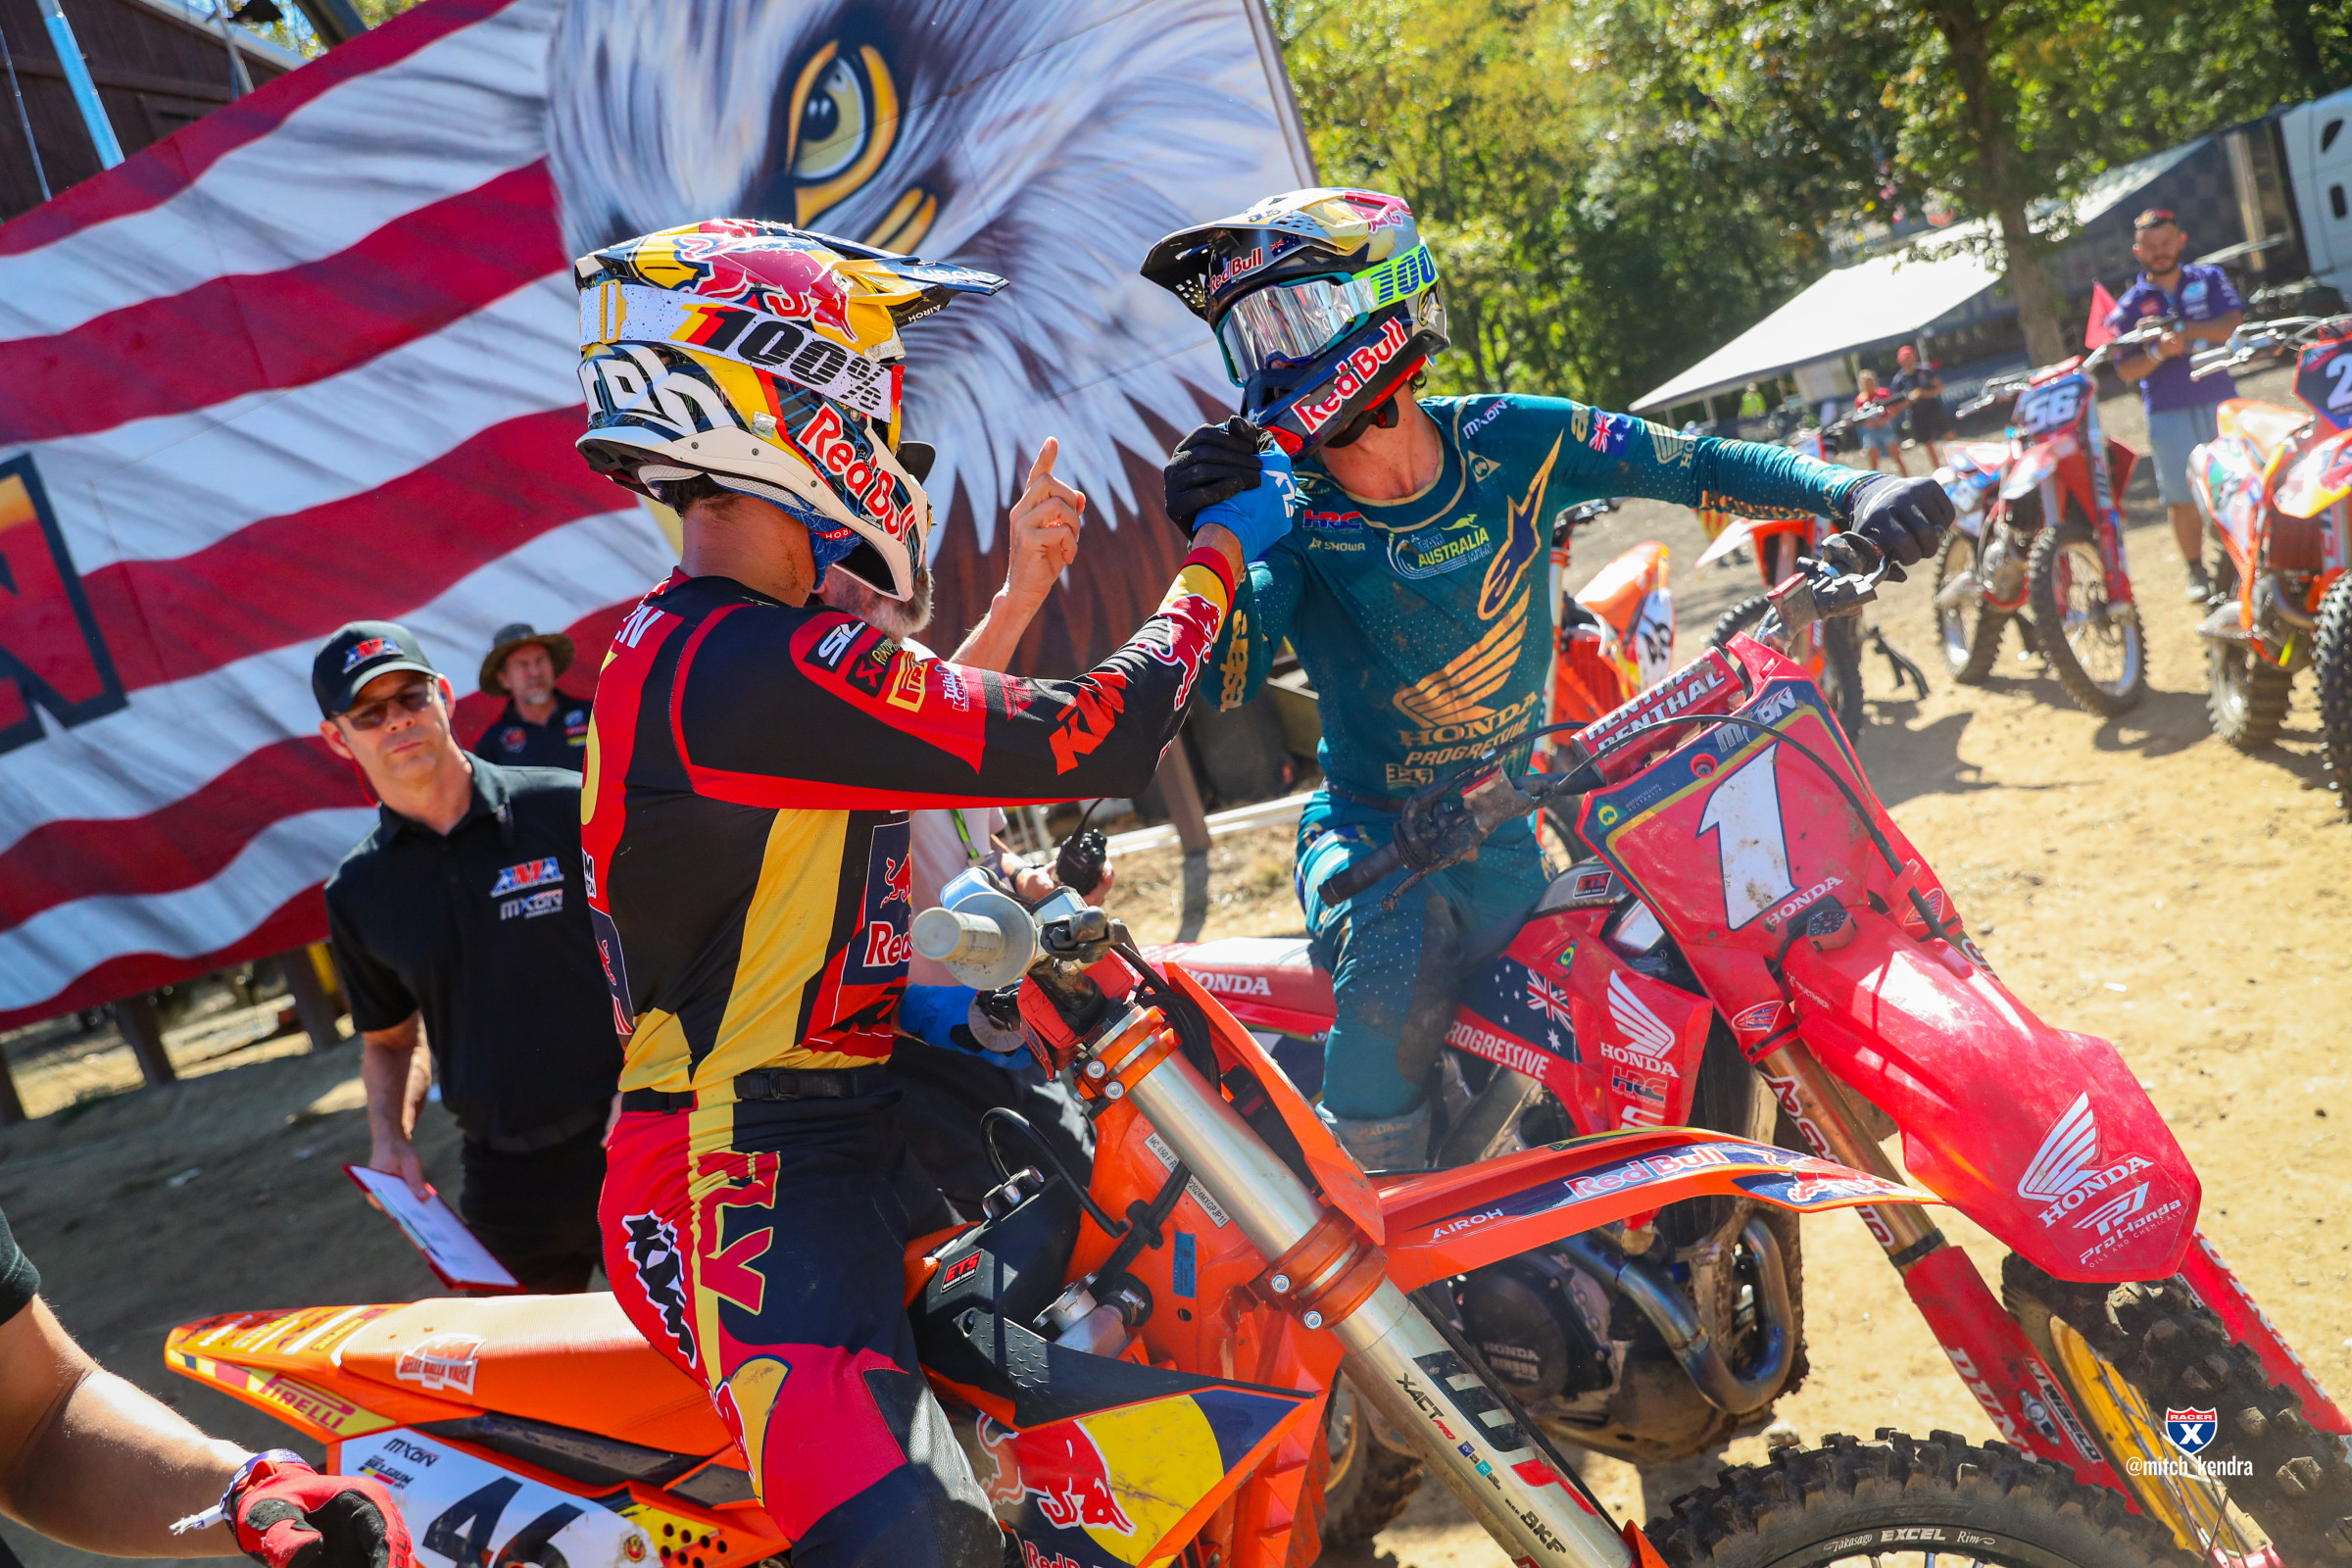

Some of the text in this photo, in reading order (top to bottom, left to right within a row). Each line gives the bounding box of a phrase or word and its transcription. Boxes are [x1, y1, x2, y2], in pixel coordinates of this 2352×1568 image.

[1209, 247, 1263, 295] Red Bull
[1291, 317, 1409, 435] Red Bull
[796, 401, 879, 501] Red
[1302, 510, 1363, 530] HRC
[1324, 541, 1366, 552] SHOWA
[1418, 527, 1491, 568] AUSTRALIA
[341, 637, 407, 675] AMA
[1397, 690, 1539, 748] HONDA
[1694, 741, 1802, 932] 1
[489, 856, 565, 899] AMA
[1767, 874, 1843, 927] HONDA
[1599, 1042, 1681, 1079] HONDA
[1612, 1065, 1668, 1103] HRC
[1148, 1135, 1161, 1150] MC
[1157, 1146, 1168, 1159] 450
[1563, 1146, 1732, 1200] Red Bull
[2038, 1155, 2155, 1229] HONDA
[1433, 1207, 1504, 1240] AIROH
[2079, 1199, 2182, 1265] Pro Honda
[2088, 1209, 2182, 1268] OILS AND CHEMICALS
[945, 1251, 981, 1283] ETS
[260, 1374, 357, 1431] PIRELLI
[1396, 1372, 1445, 1420] XACT
[364, 1457, 415, 1485] BELGIUM
[1825, 1527, 1996, 1553] Takasago EXCEL Rim
